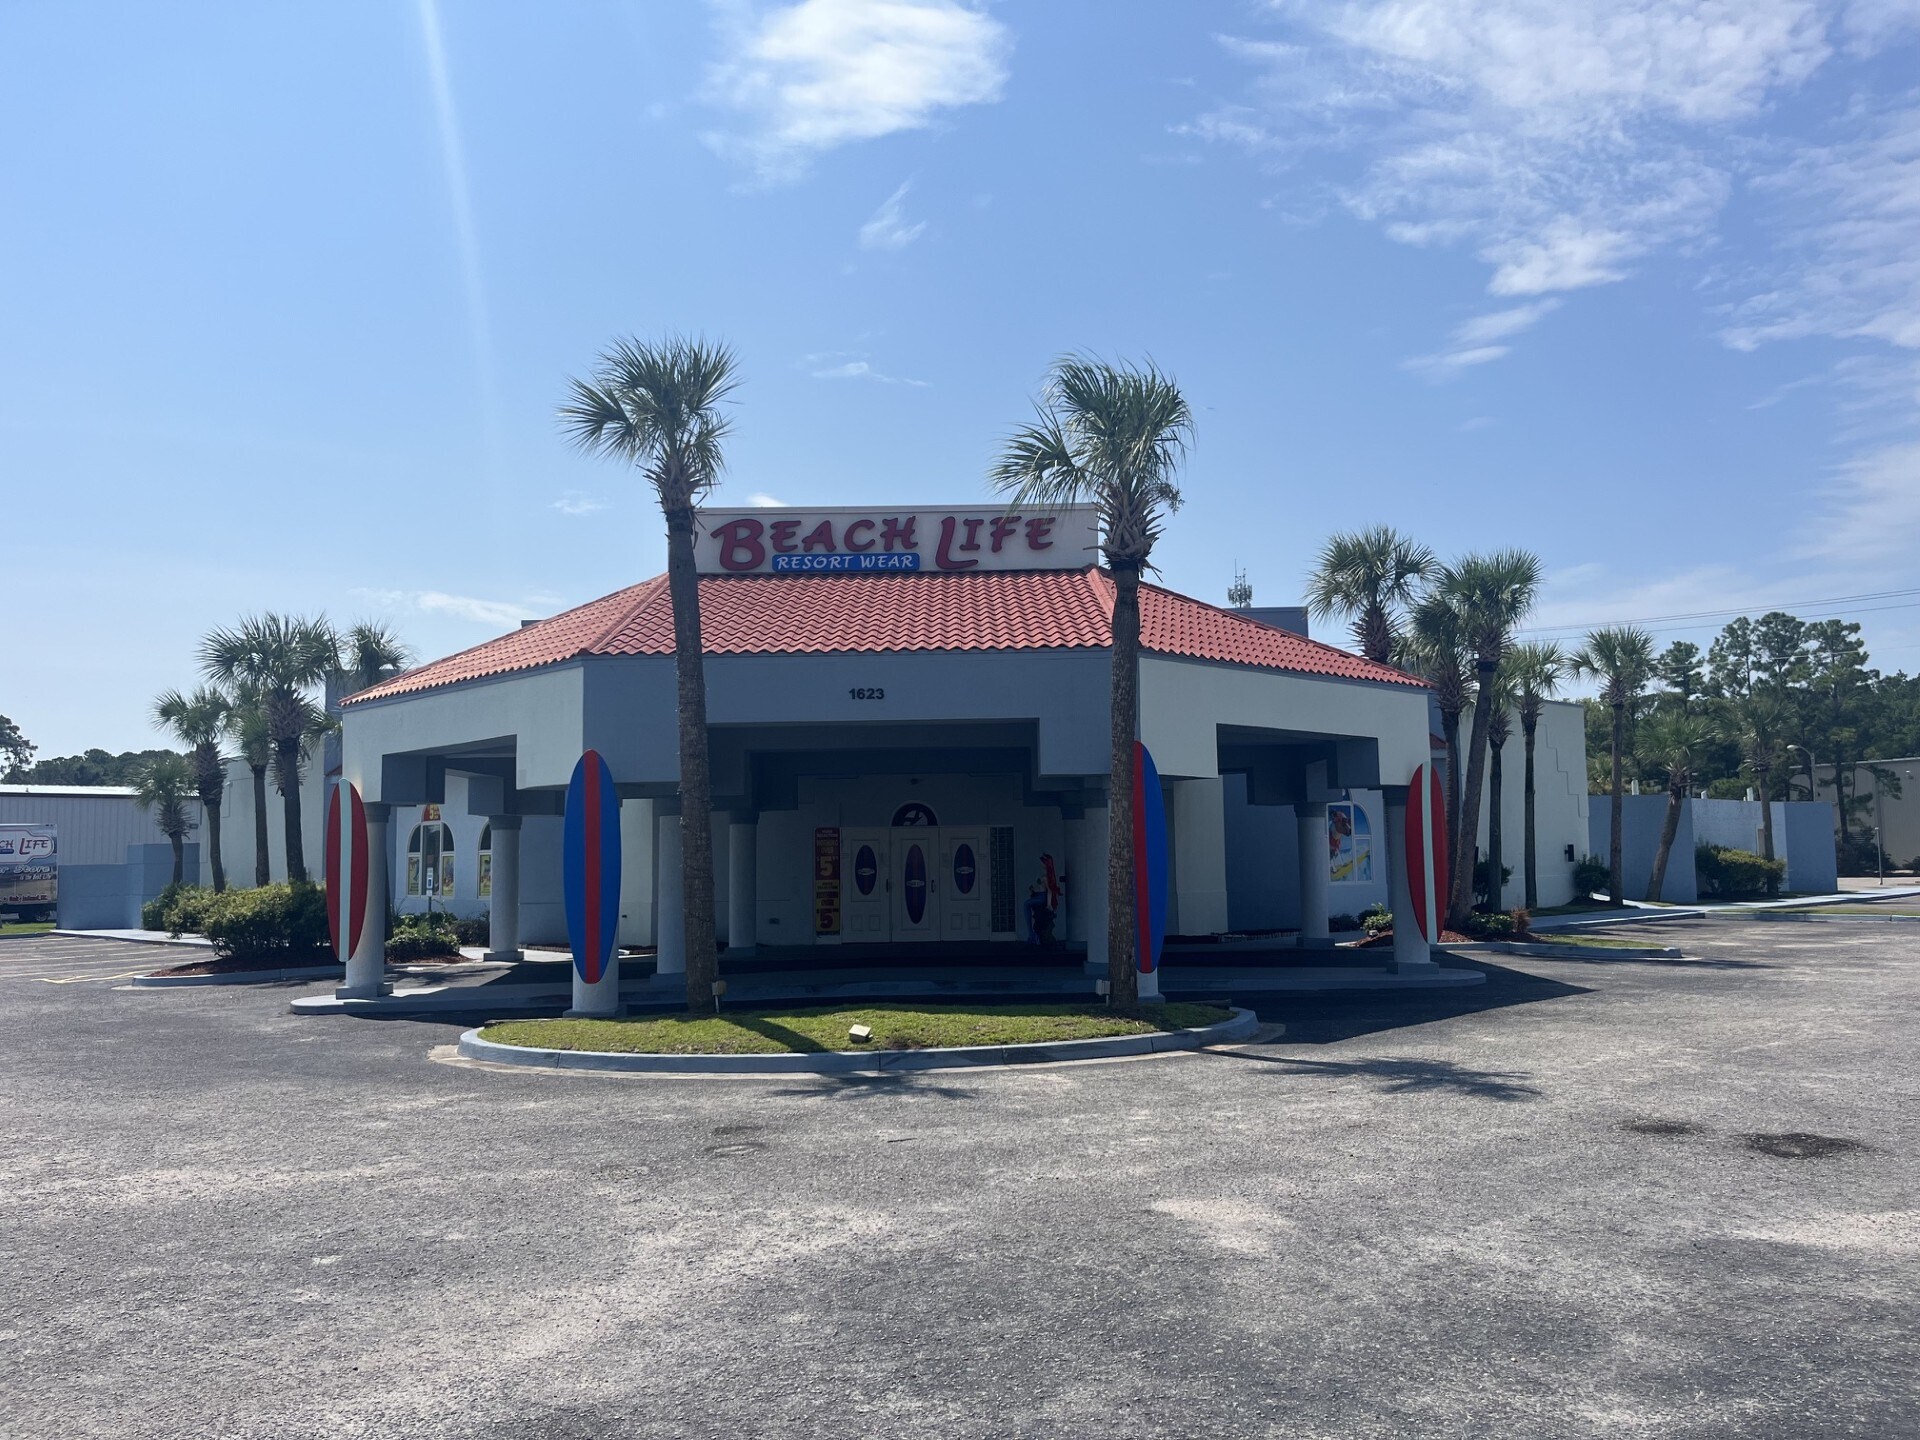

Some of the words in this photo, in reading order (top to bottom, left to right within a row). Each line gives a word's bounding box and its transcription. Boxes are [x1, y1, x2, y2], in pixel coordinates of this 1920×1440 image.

[710, 515, 919, 572] BEACH
[934, 515, 1058, 570] LIFE
[775, 555, 854, 570] RESORT
[860, 554, 916, 569] WEAR
[848, 687, 885, 700] 1623
[19, 837, 49, 855] LIFE
